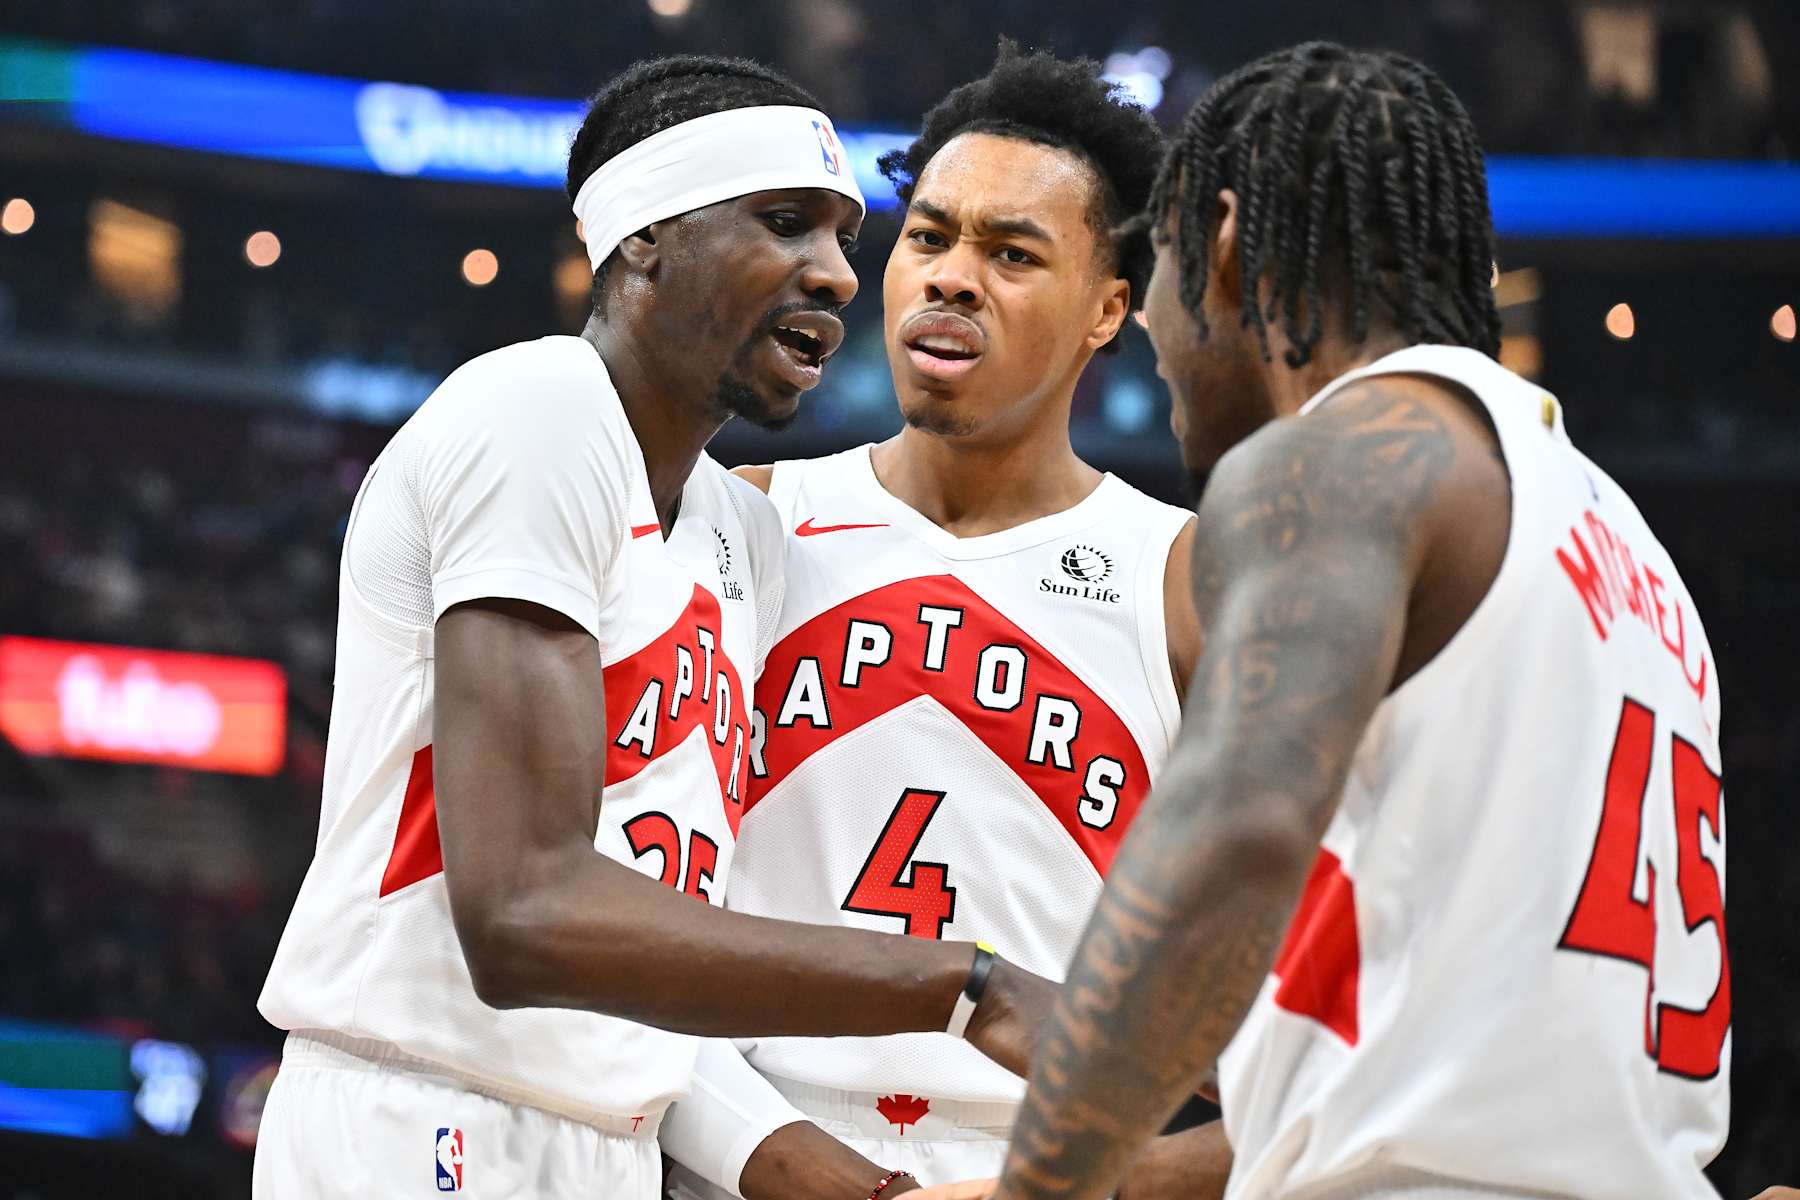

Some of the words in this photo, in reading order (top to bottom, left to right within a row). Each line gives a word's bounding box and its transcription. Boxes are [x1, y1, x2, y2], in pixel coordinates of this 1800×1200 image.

[722, 581, 744, 601] Life
[1039, 578, 1078, 597] Sun
[1083, 586, 1121, 604] Life
[614, 625, 744, 804] APTOR
[840, 787, 957, 940] 4
[1555, 695, 1732, 1082] 45
[438, 1176, 452, 1189] NBA
